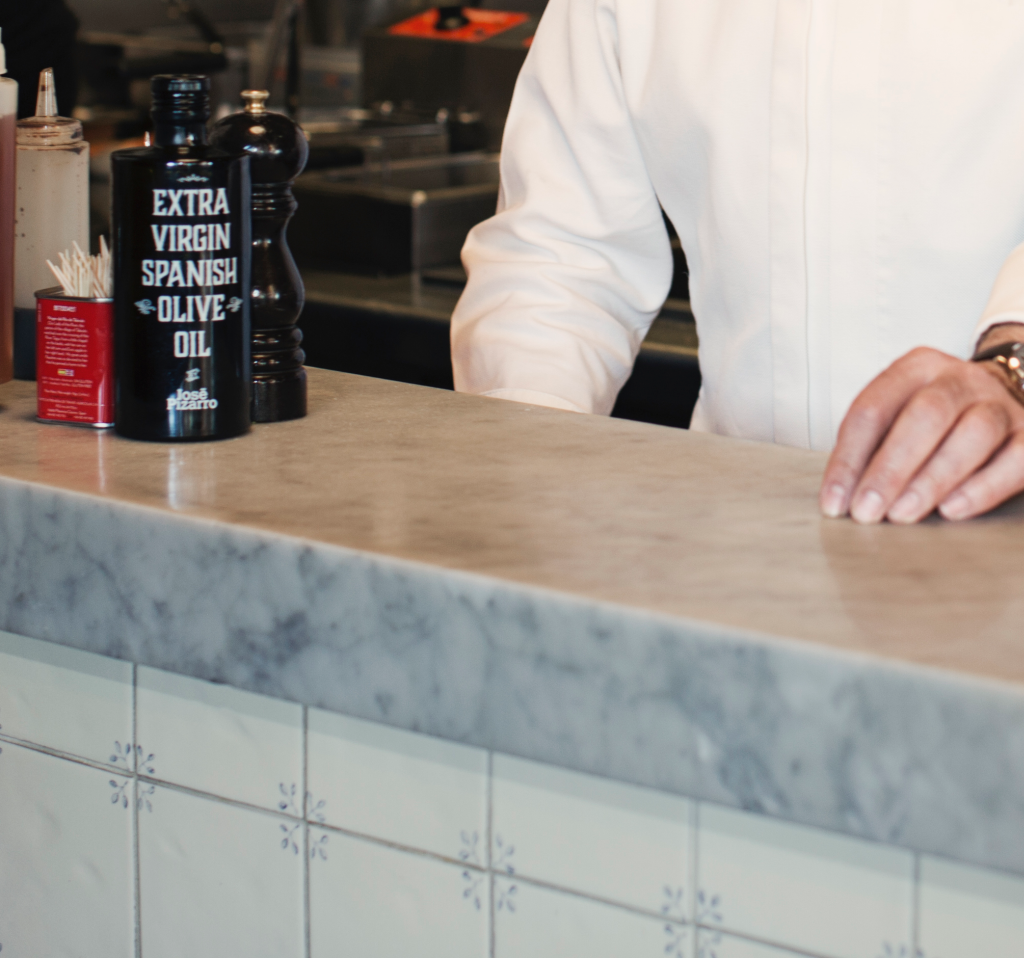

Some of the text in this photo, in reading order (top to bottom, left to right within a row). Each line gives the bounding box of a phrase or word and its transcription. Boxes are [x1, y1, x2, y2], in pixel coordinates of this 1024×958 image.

[152, 187, 230, 216] EXTRA
[150, 222, 231, 252] VIRGIN
[142, 257, 238, 287] SPANISH
[157, 294, 226, 323] OLIVE
[173, 330, 212, 358] OIL
[166, 398, 218, 411] Pizarro
[176, 387, 209, 400] José
